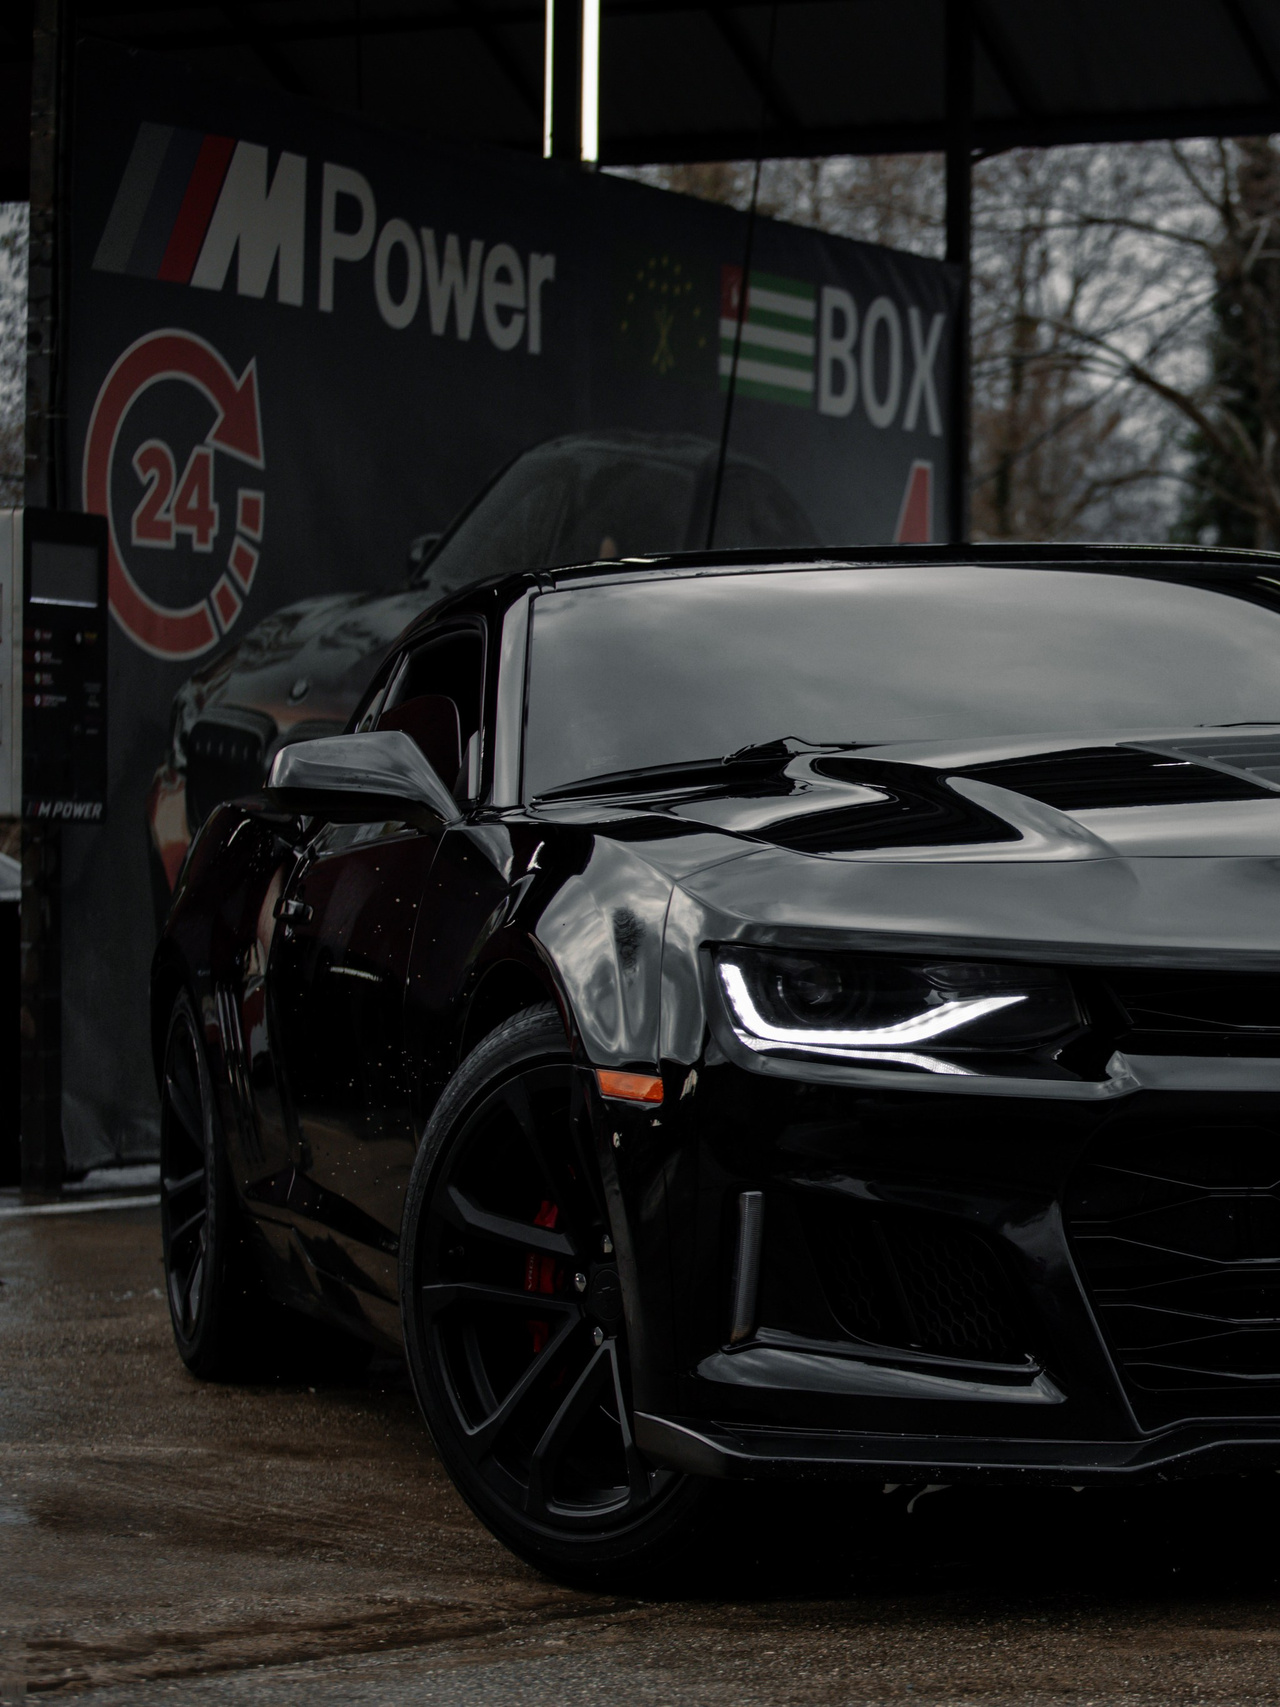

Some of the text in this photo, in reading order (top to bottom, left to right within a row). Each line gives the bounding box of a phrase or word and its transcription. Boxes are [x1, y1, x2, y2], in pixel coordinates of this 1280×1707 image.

[817, 284, 947, 437] BOX
[131, 438, 220, 553] 24
[51, 801, 103, 820] POWER
